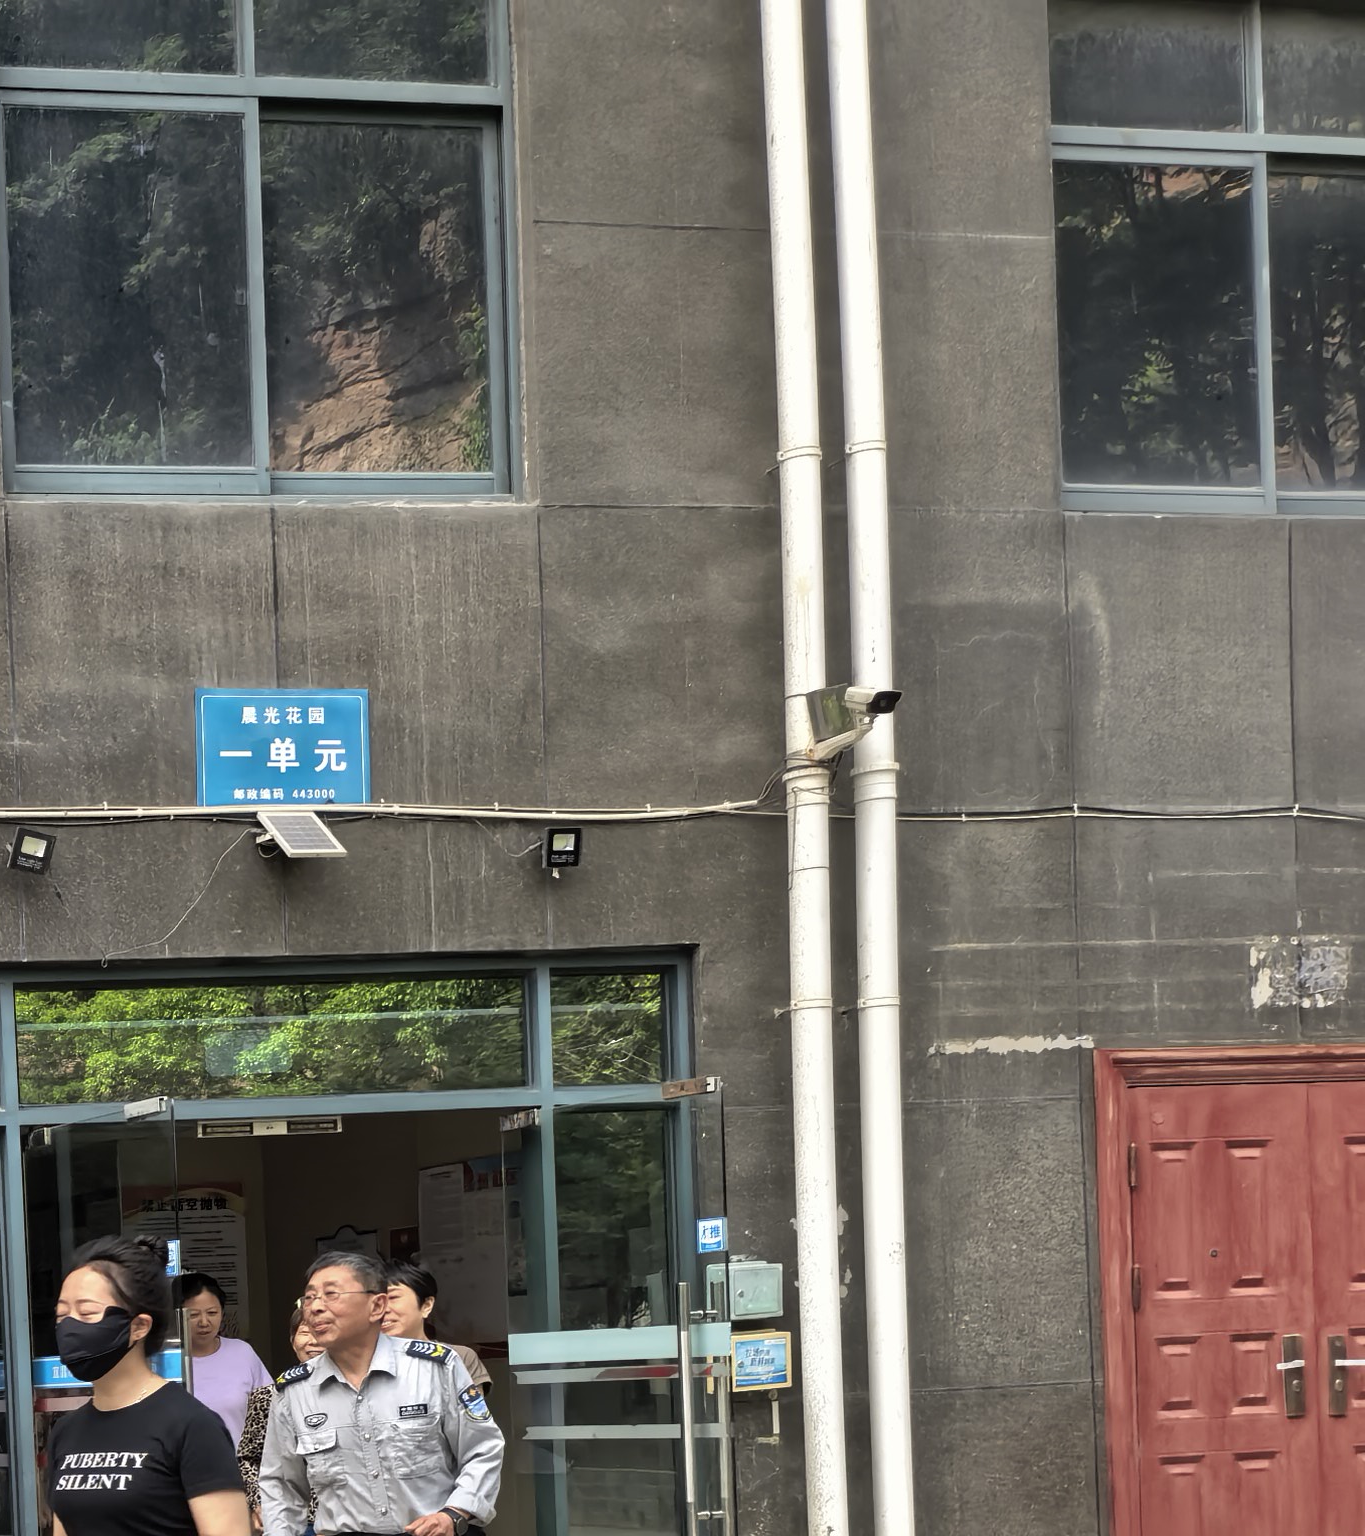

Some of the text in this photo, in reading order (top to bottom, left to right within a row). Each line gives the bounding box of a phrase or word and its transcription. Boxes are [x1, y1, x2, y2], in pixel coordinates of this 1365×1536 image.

[241, 706, 325, 724] 晨光花园
[219, 737, 347, 773] 一单元
[233, 788, 335, 800] 邮政编码 443000
[60, 1452, 148, 1470] PUBERTY
[56, 1474, 132, 1490] SILENT
